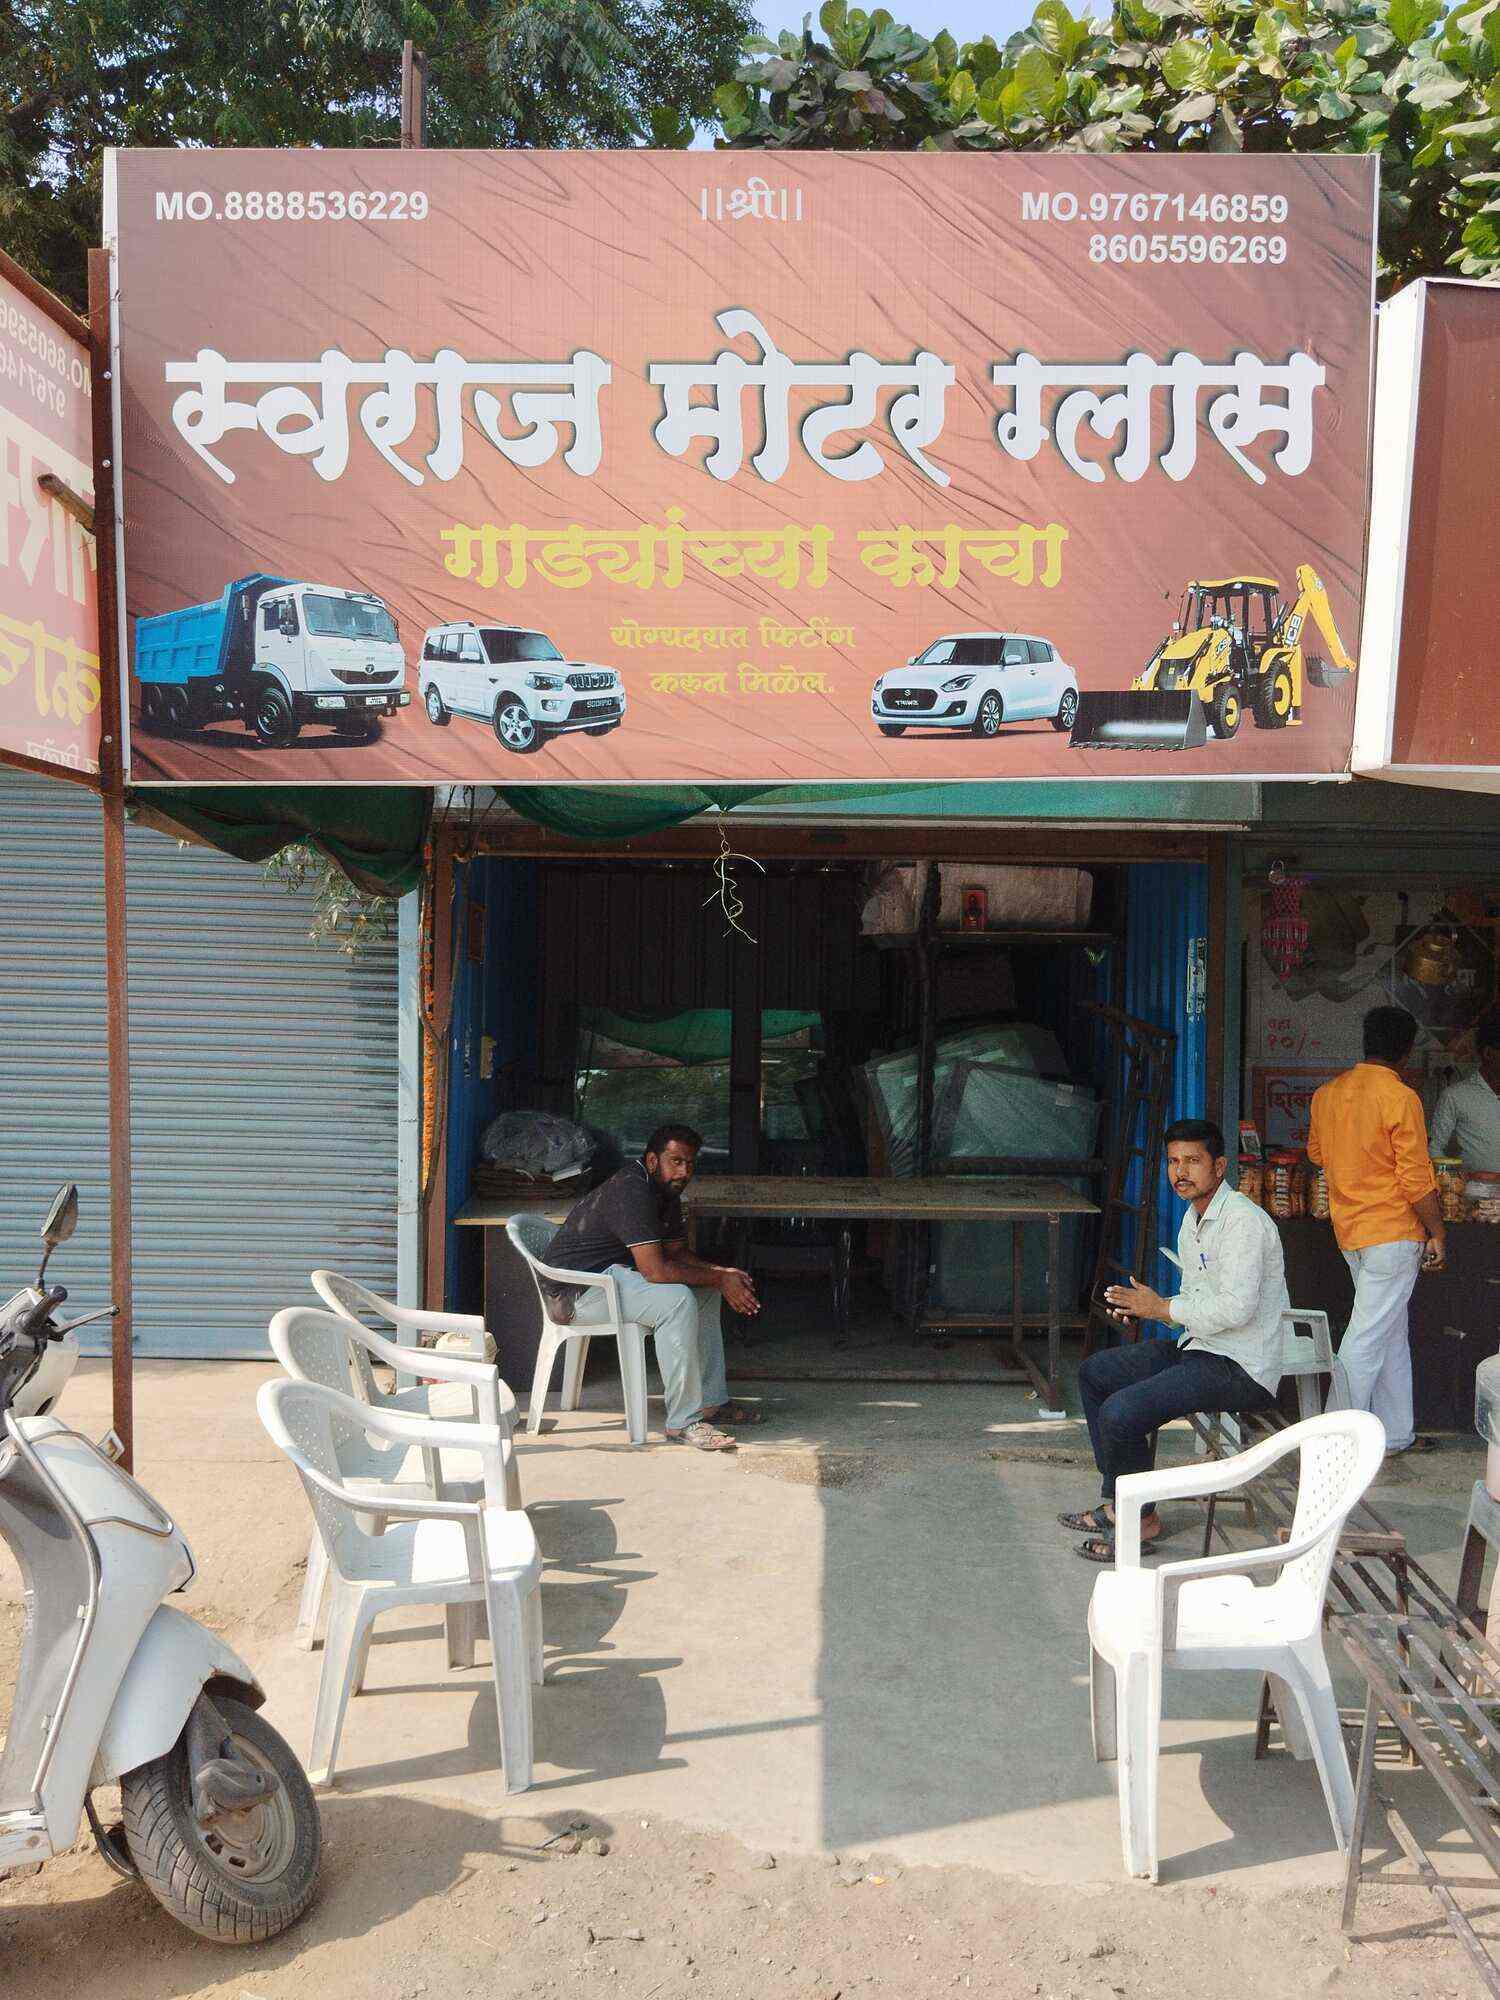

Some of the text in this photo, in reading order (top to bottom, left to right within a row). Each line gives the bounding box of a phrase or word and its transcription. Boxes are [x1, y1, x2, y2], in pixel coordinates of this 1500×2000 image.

[154, 190, 429, 221] MO.8888536229
[1021, 192, 1289, 223] MO.9767146859
[1088, 234, 1287, 264] 8605596269
[165, 309, 1327, 488] स्वराज मोटर ग्लास
[439, 505, 1069, 590] गाड्यांच्या काचा
